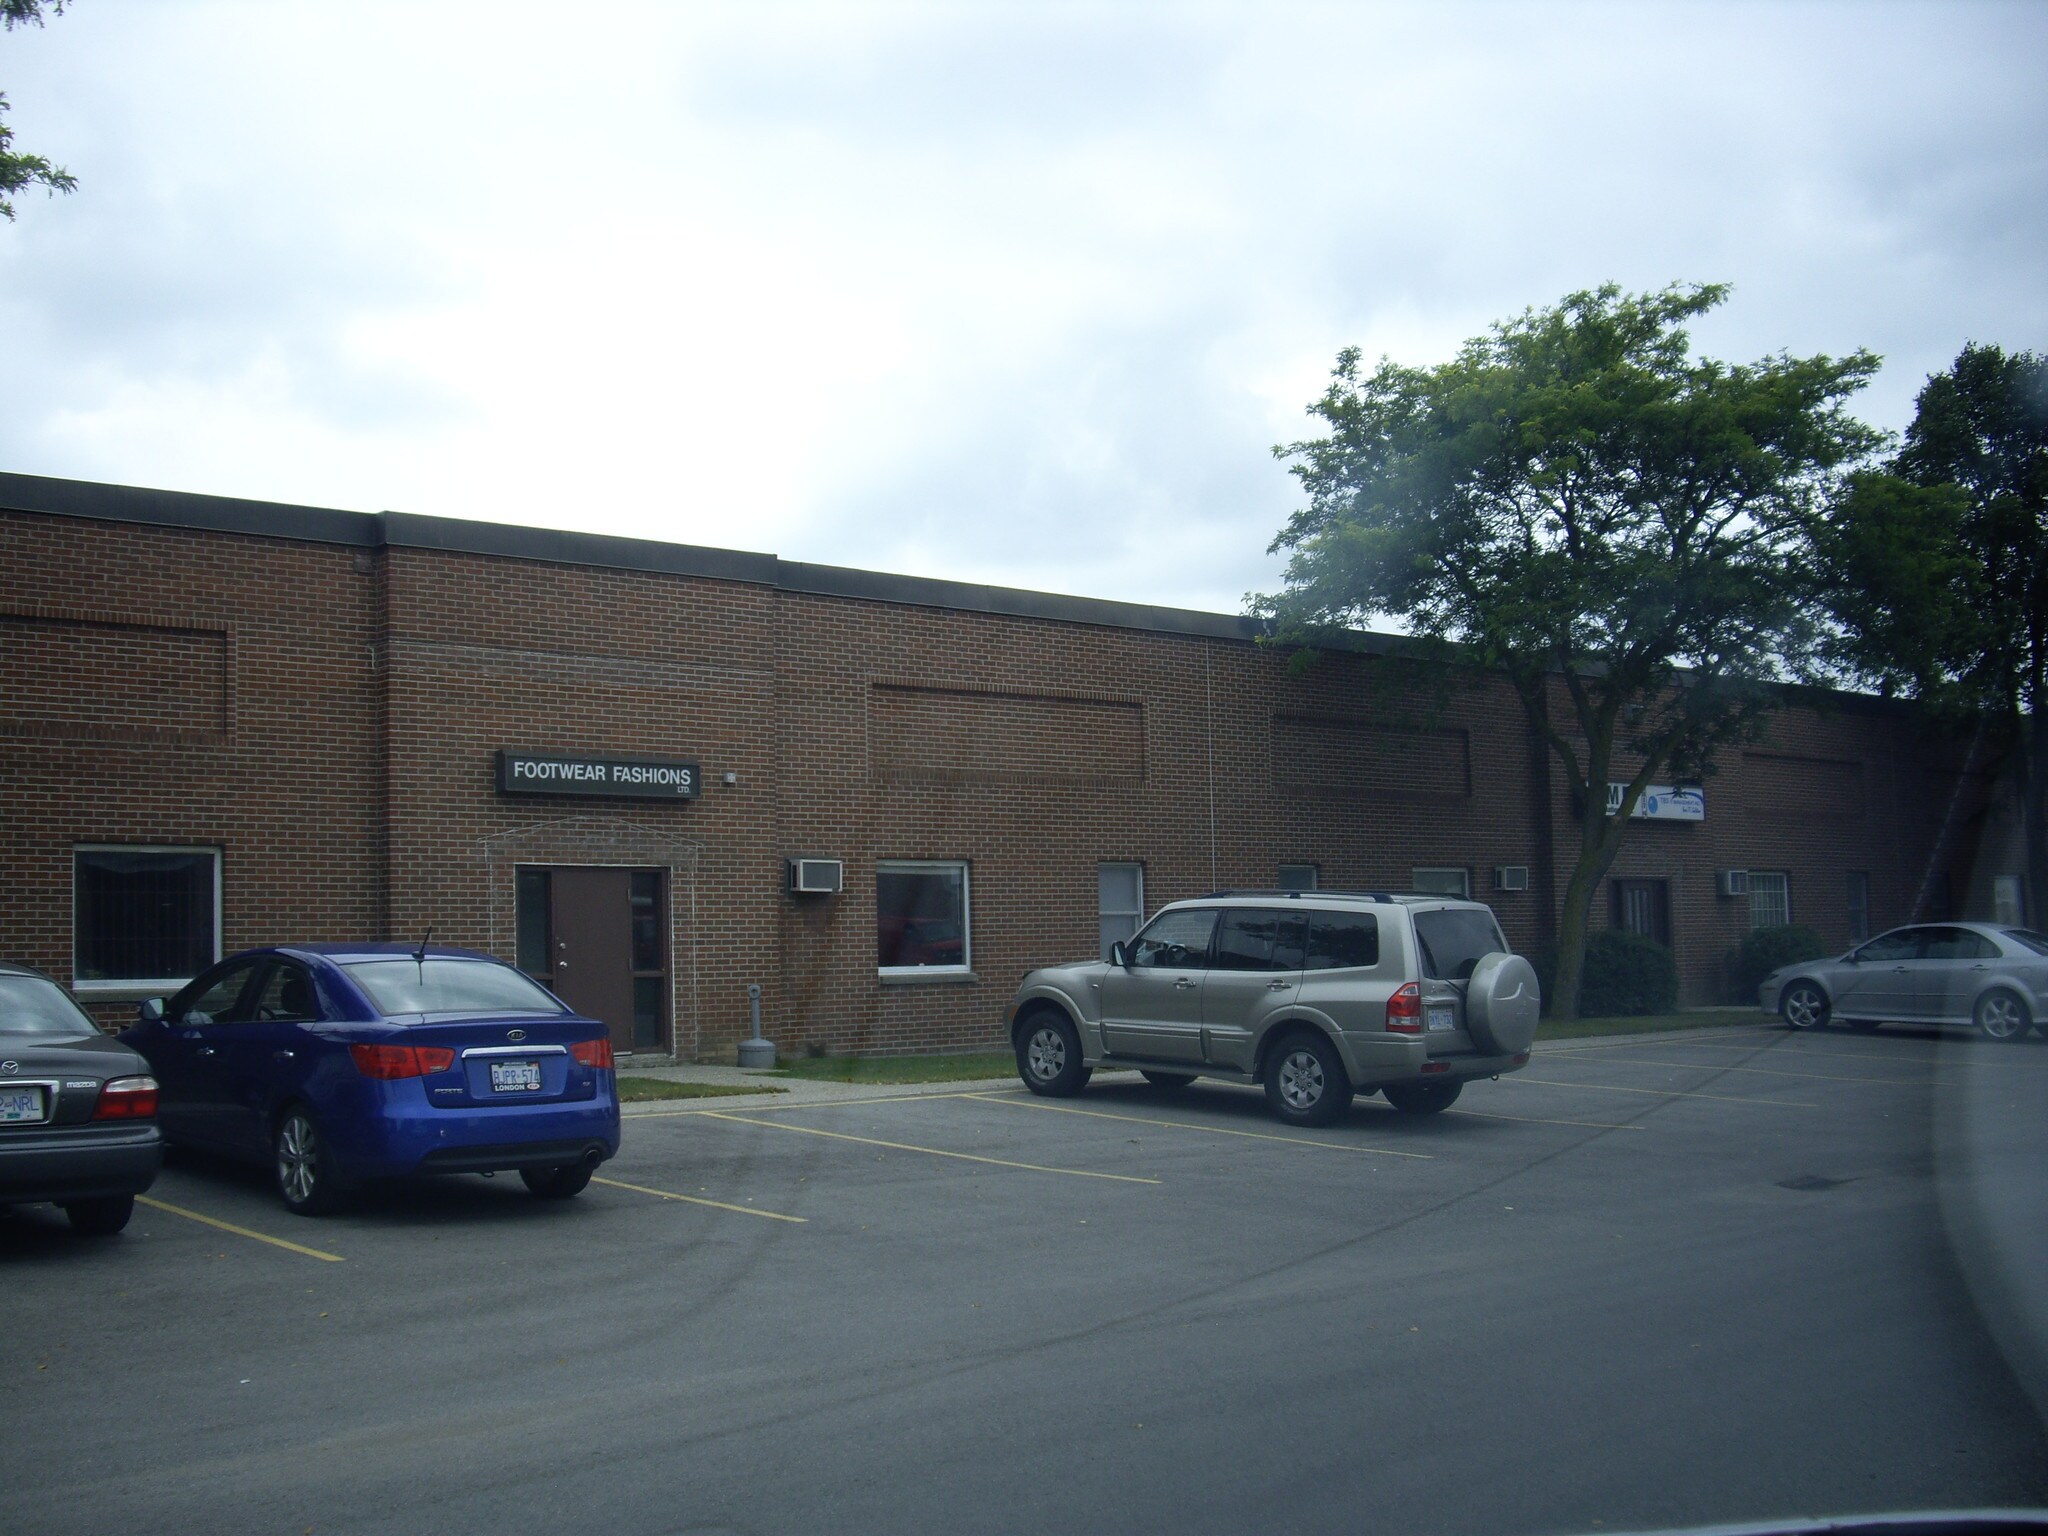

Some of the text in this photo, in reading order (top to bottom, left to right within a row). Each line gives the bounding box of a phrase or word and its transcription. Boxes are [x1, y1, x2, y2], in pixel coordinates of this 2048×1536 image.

[514, 761, 691, 785] FOOTWEAR FASHIONS
[677, 785, 691, 794] LTD.
[494, 1084, 525, 1092] LONDON
[12, 1096, 40, 1112] NRL
